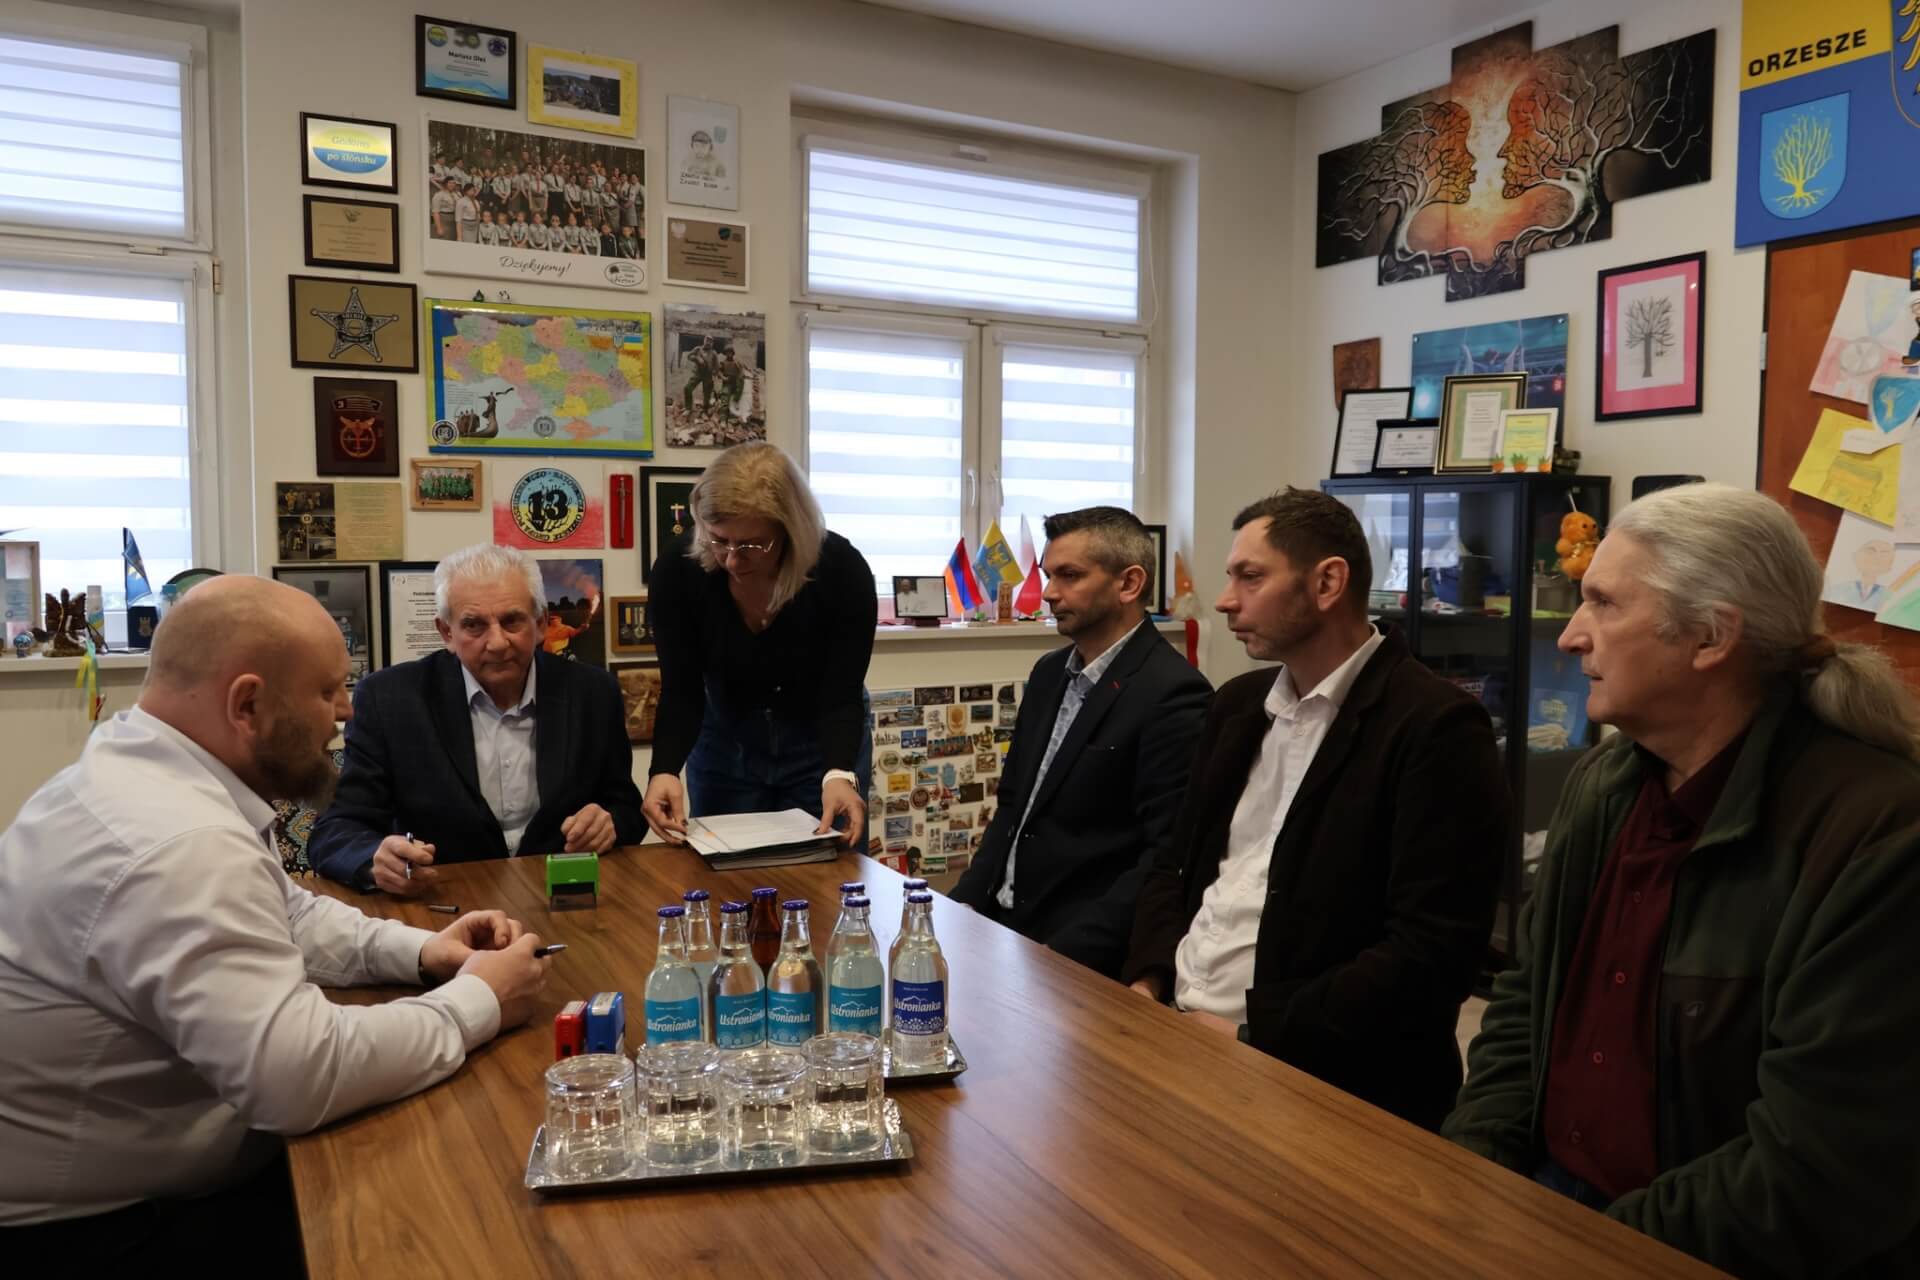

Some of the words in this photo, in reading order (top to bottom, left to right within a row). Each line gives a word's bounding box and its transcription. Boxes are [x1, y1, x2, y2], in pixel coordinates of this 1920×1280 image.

[1748, 29, 1868, 77] ORZESZE
[499, 256, 572, 277] Dziękujemy!
[528, 488, 568, 531] 13
[831, 1002, 879, 1018] Ustronianka
